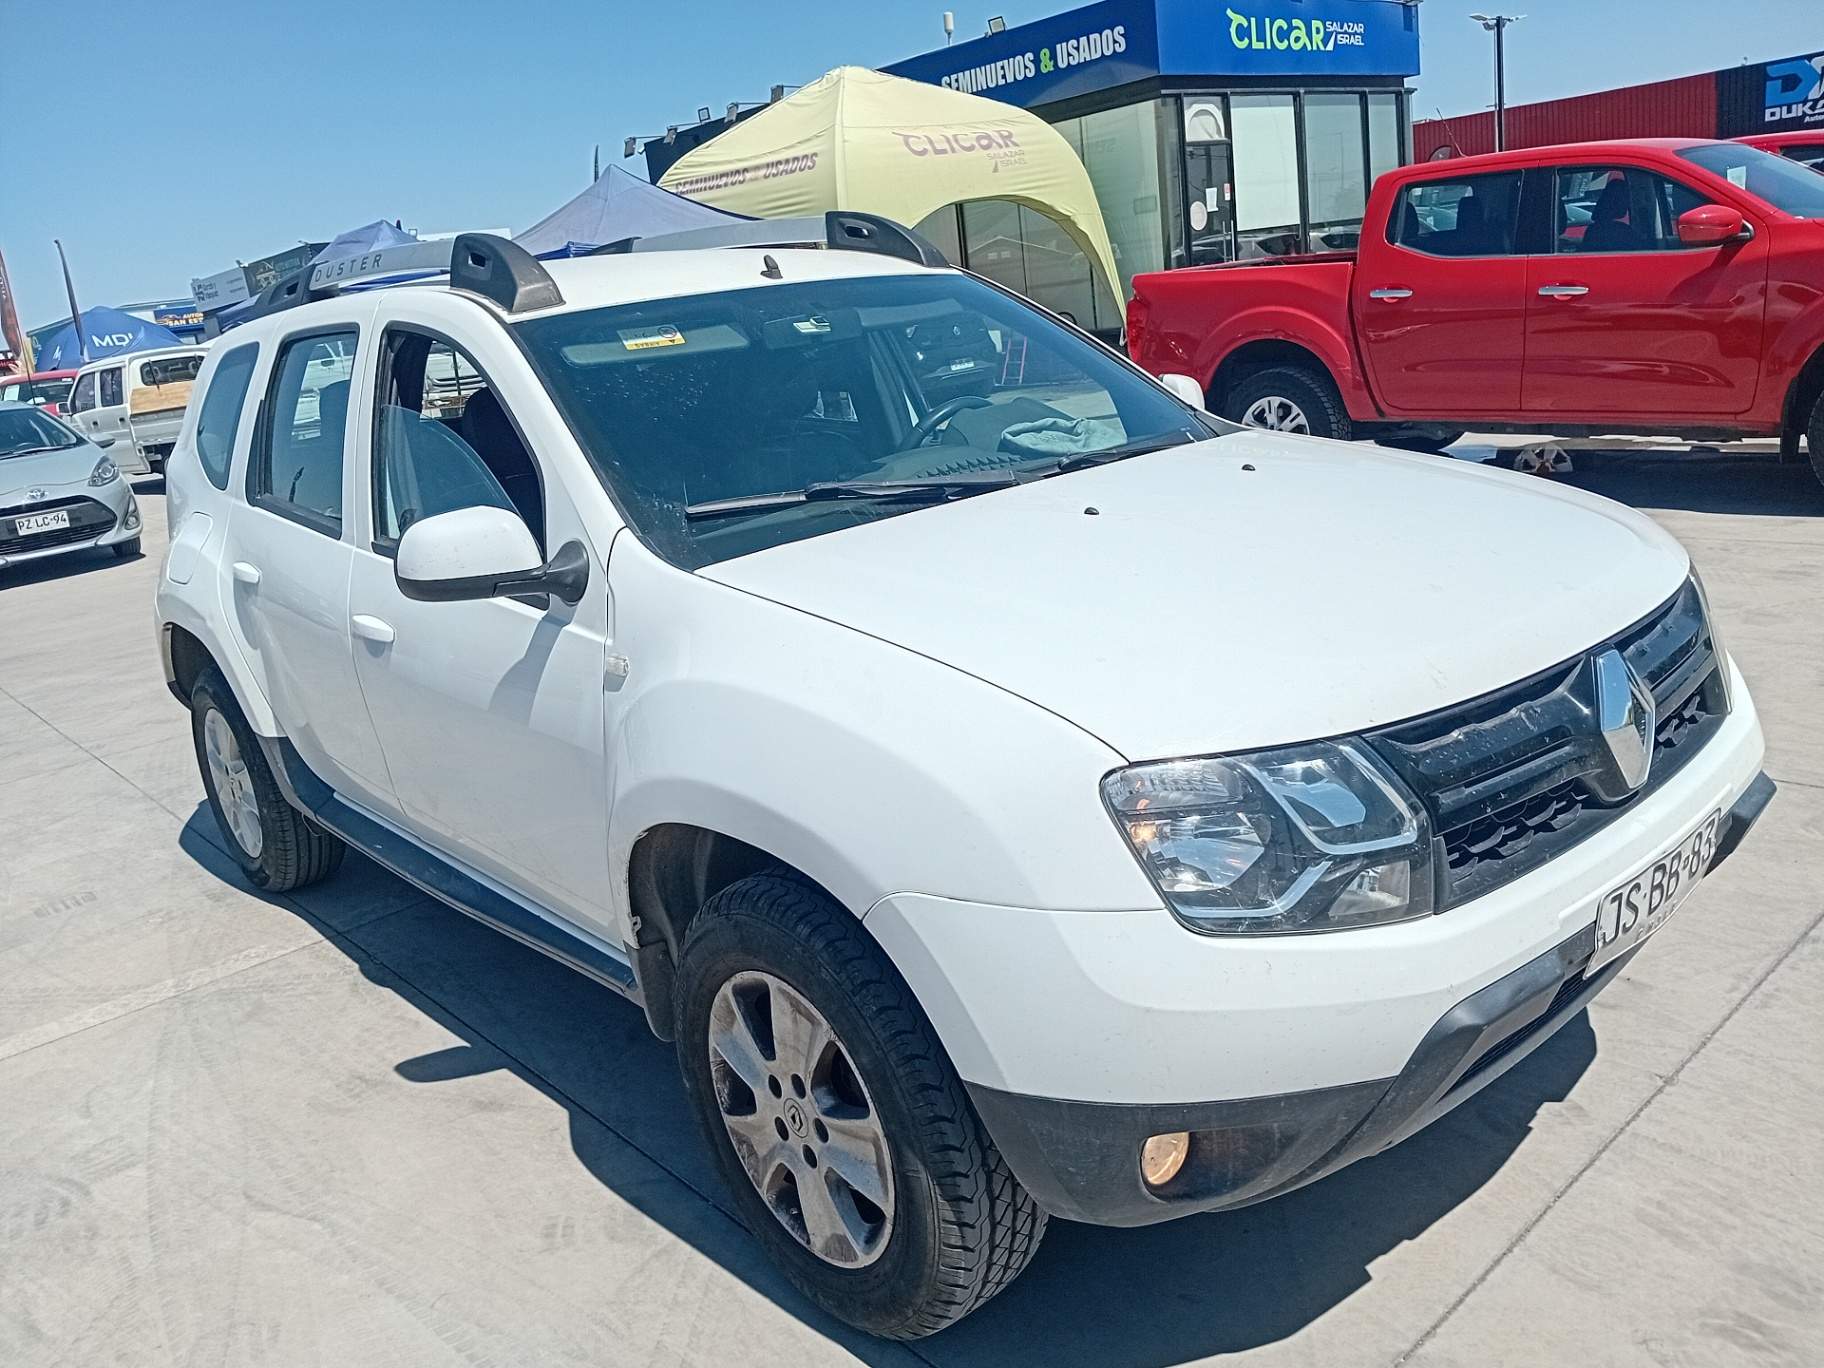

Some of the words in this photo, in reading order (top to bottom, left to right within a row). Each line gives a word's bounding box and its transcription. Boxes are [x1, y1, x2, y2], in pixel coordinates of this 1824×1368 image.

[1325, 21, 1364, 33] SALAZAR
[1337, 34, 1364, 45] ISRAEL
[941, 52, 1036, 94] SEMINUEVOS
[1039, 48, 1054, 74] &
[1056, 25, 1126, 69] USADOS
[763, 152, 818, 180] USADOS
[315, 254, 382, 282] DUSTER
